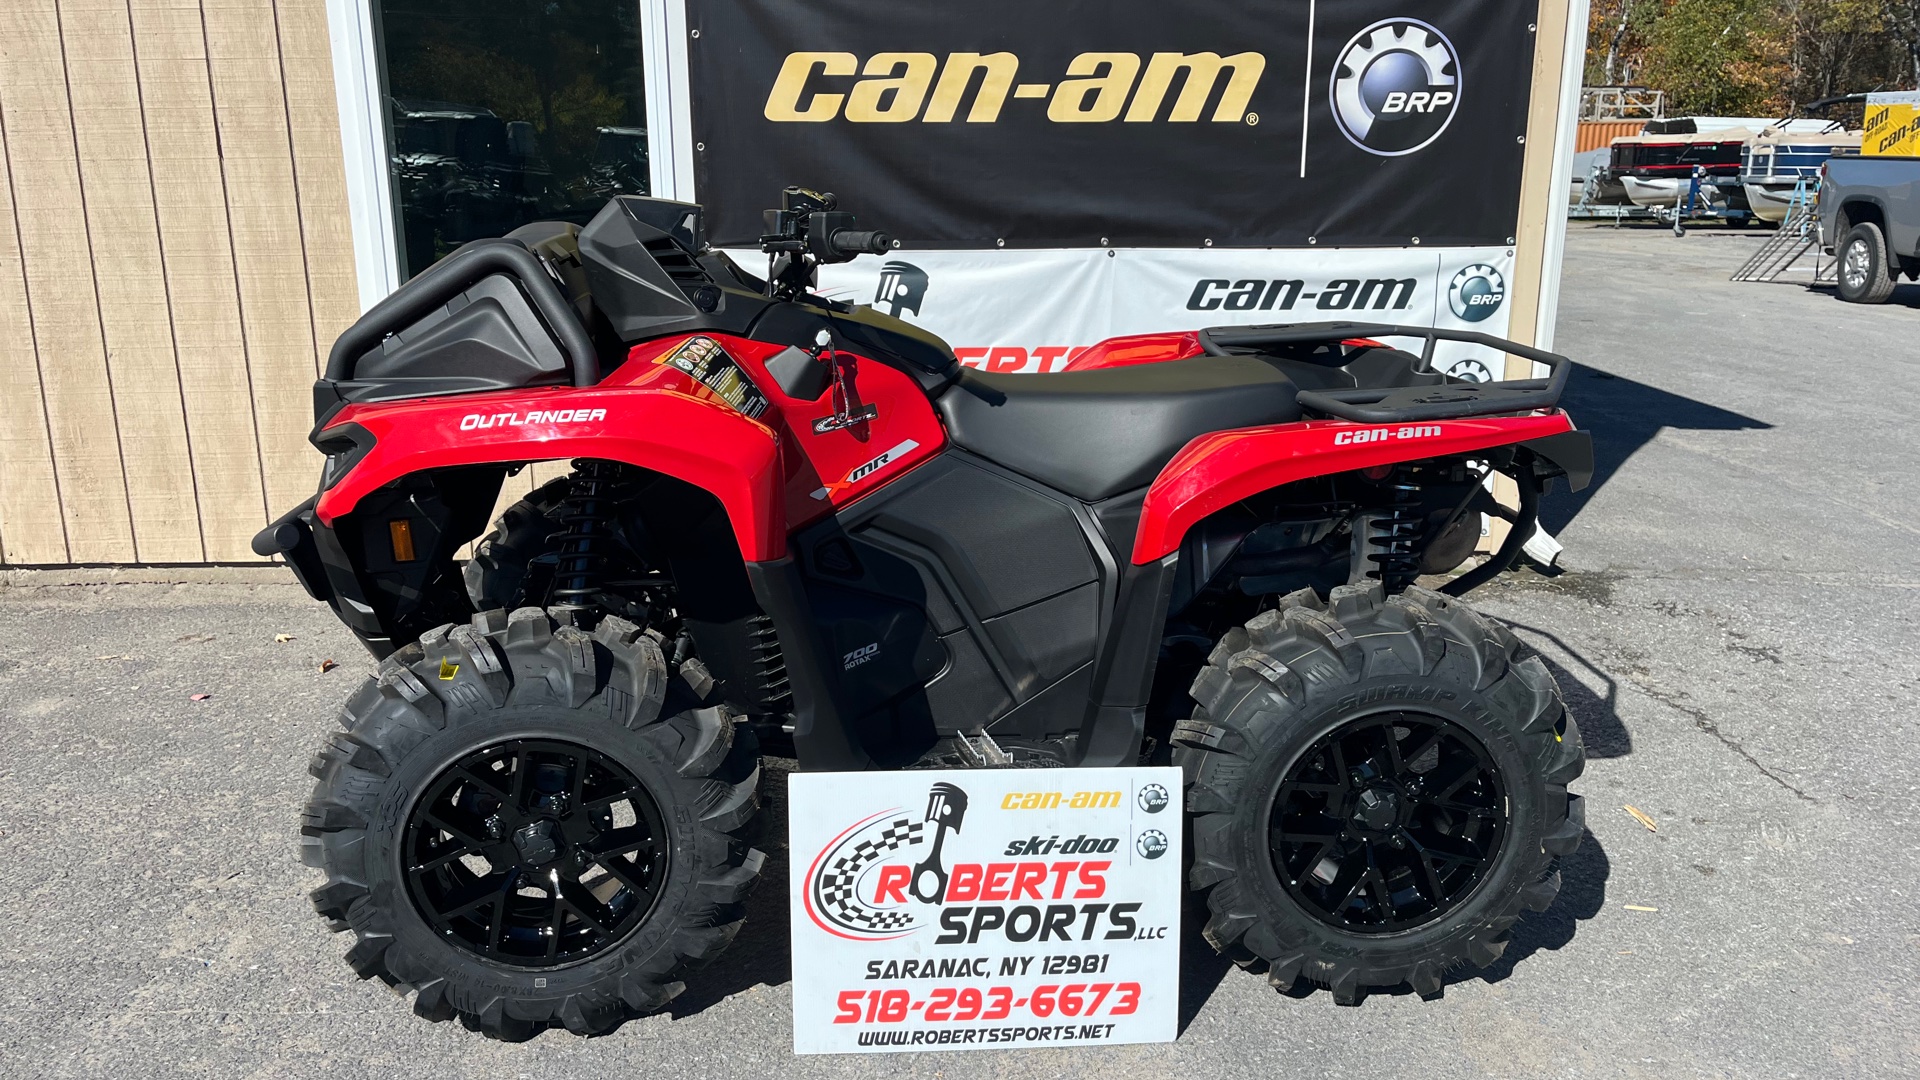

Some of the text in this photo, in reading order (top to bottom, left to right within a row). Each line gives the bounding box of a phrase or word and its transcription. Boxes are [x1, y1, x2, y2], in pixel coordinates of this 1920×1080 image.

[764, 51, 1266, 124] can-am
[1381, 91, 1453, 113] BRP
[1186, 278, 1417, 311] can-am
[1469, 295, 1502, 306] BRP
[459, 408, 607, 431] OUTLANDER
[1334, 425, 1441, 446] can-am
[843, 642, 878, 664] 700
[844, 655, 871, 671] ROTAX
[1336, 683, 1458, 714] SWAMP
[1000, 791, 1122, 810] can-am
[1003, 834, 1120, 856] ski-doo
[873, 861, 1112, 905] ROBERTS
[864, 954, 1110, 980] SARANAC, NY 12981
[832, 981, 1142, 1024] 518-293-6673
